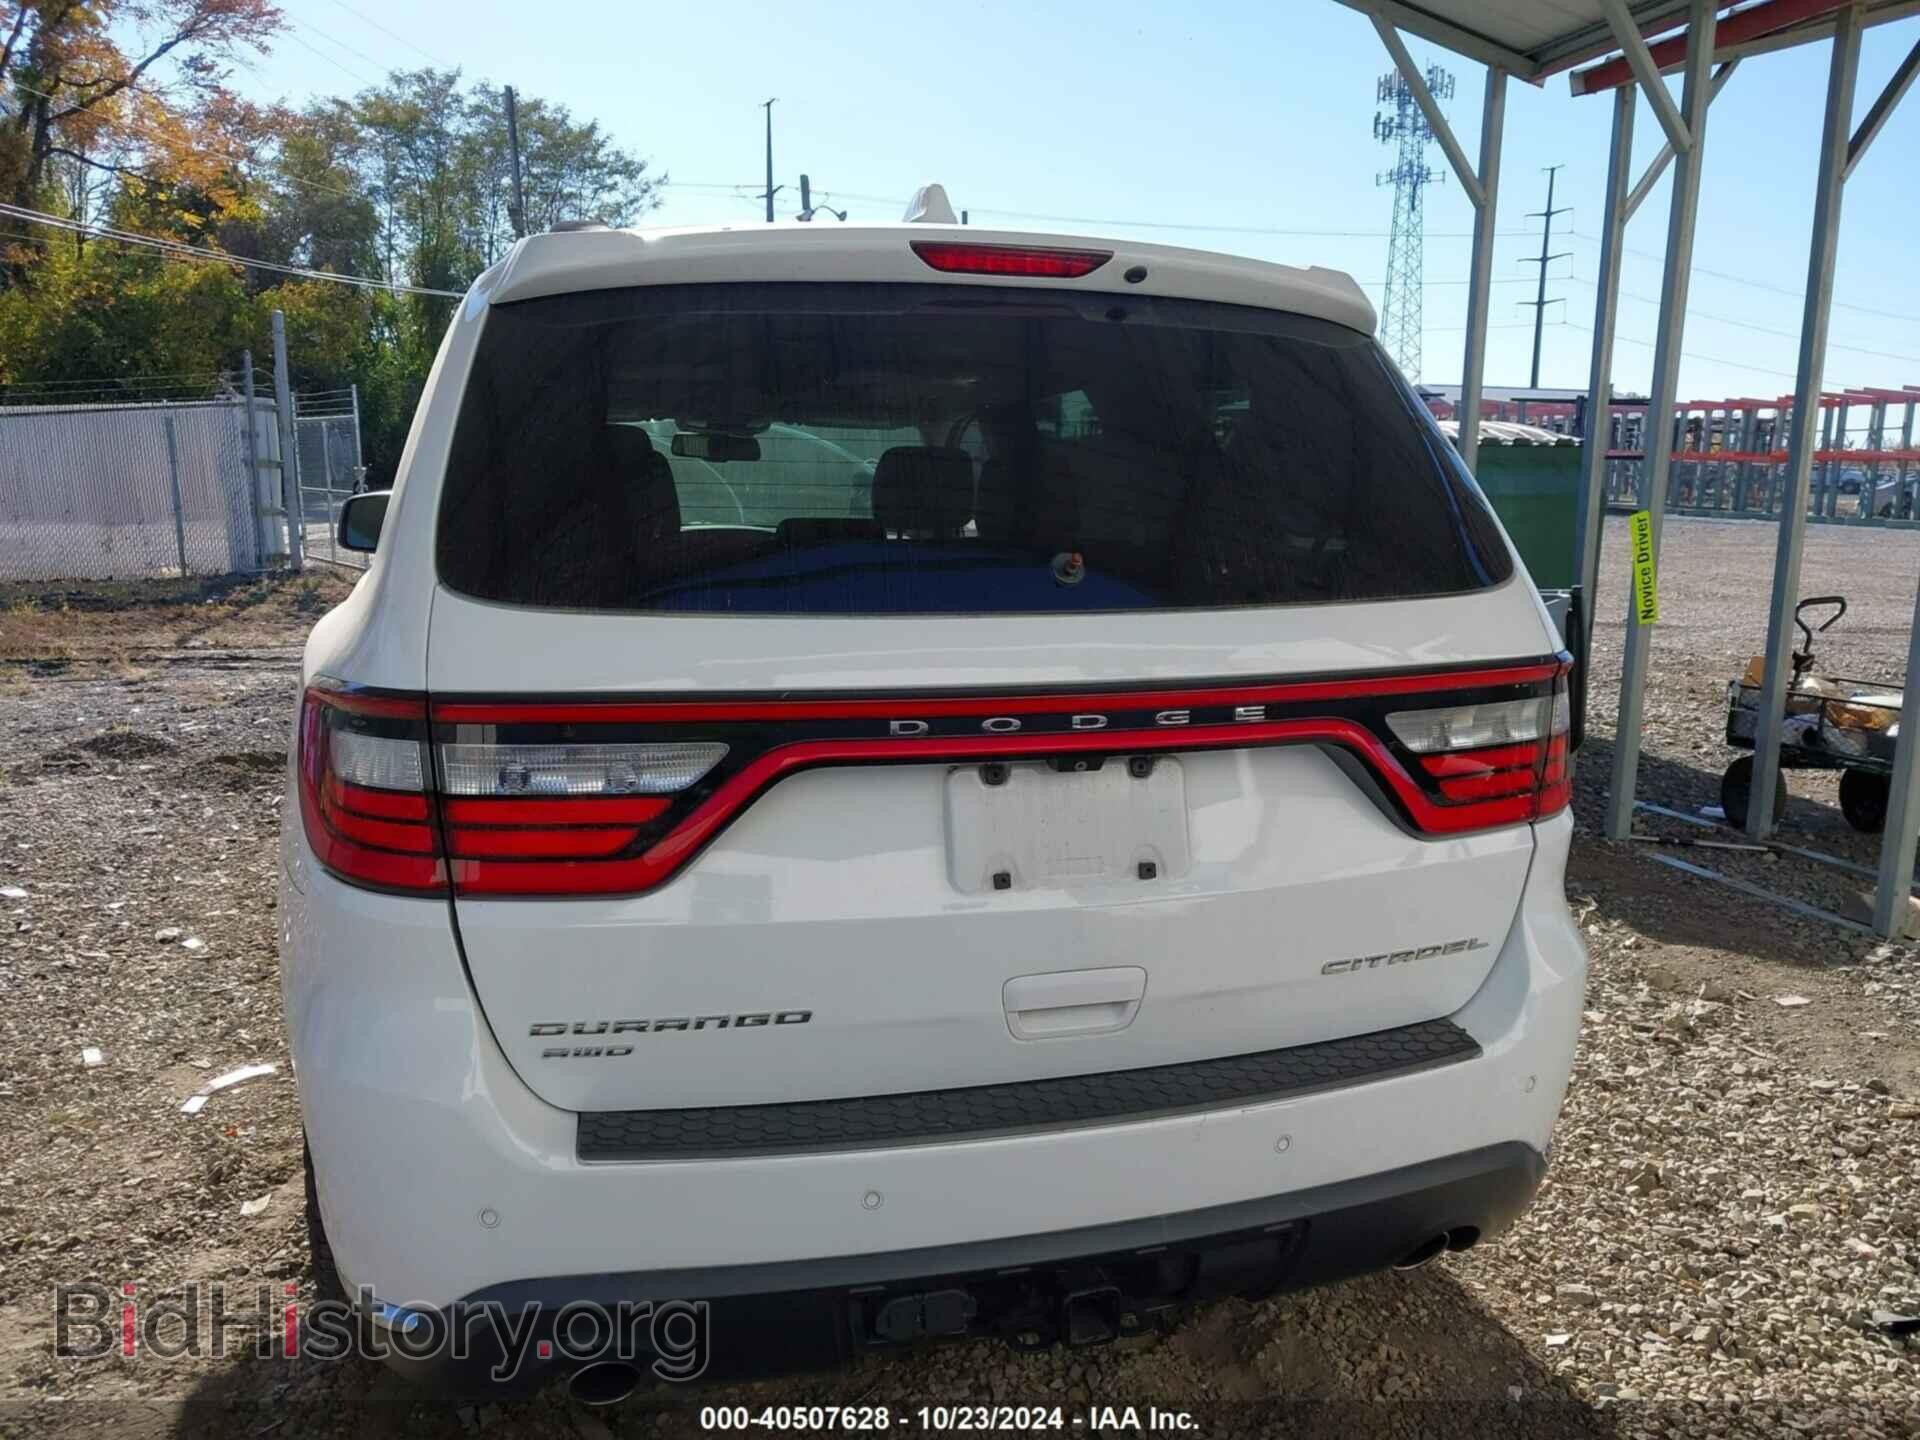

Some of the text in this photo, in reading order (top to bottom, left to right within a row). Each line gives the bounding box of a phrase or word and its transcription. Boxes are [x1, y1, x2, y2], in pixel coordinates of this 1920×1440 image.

[1636, 516, 1655, 621] Novice Driver
[889, 705, 1267, 737] DODGE
[1320, 936, 1490, 976] CITADEL
[528, 1007, 814, 1037] DURANGO
[541, 1043, 635, 1059] AWD
